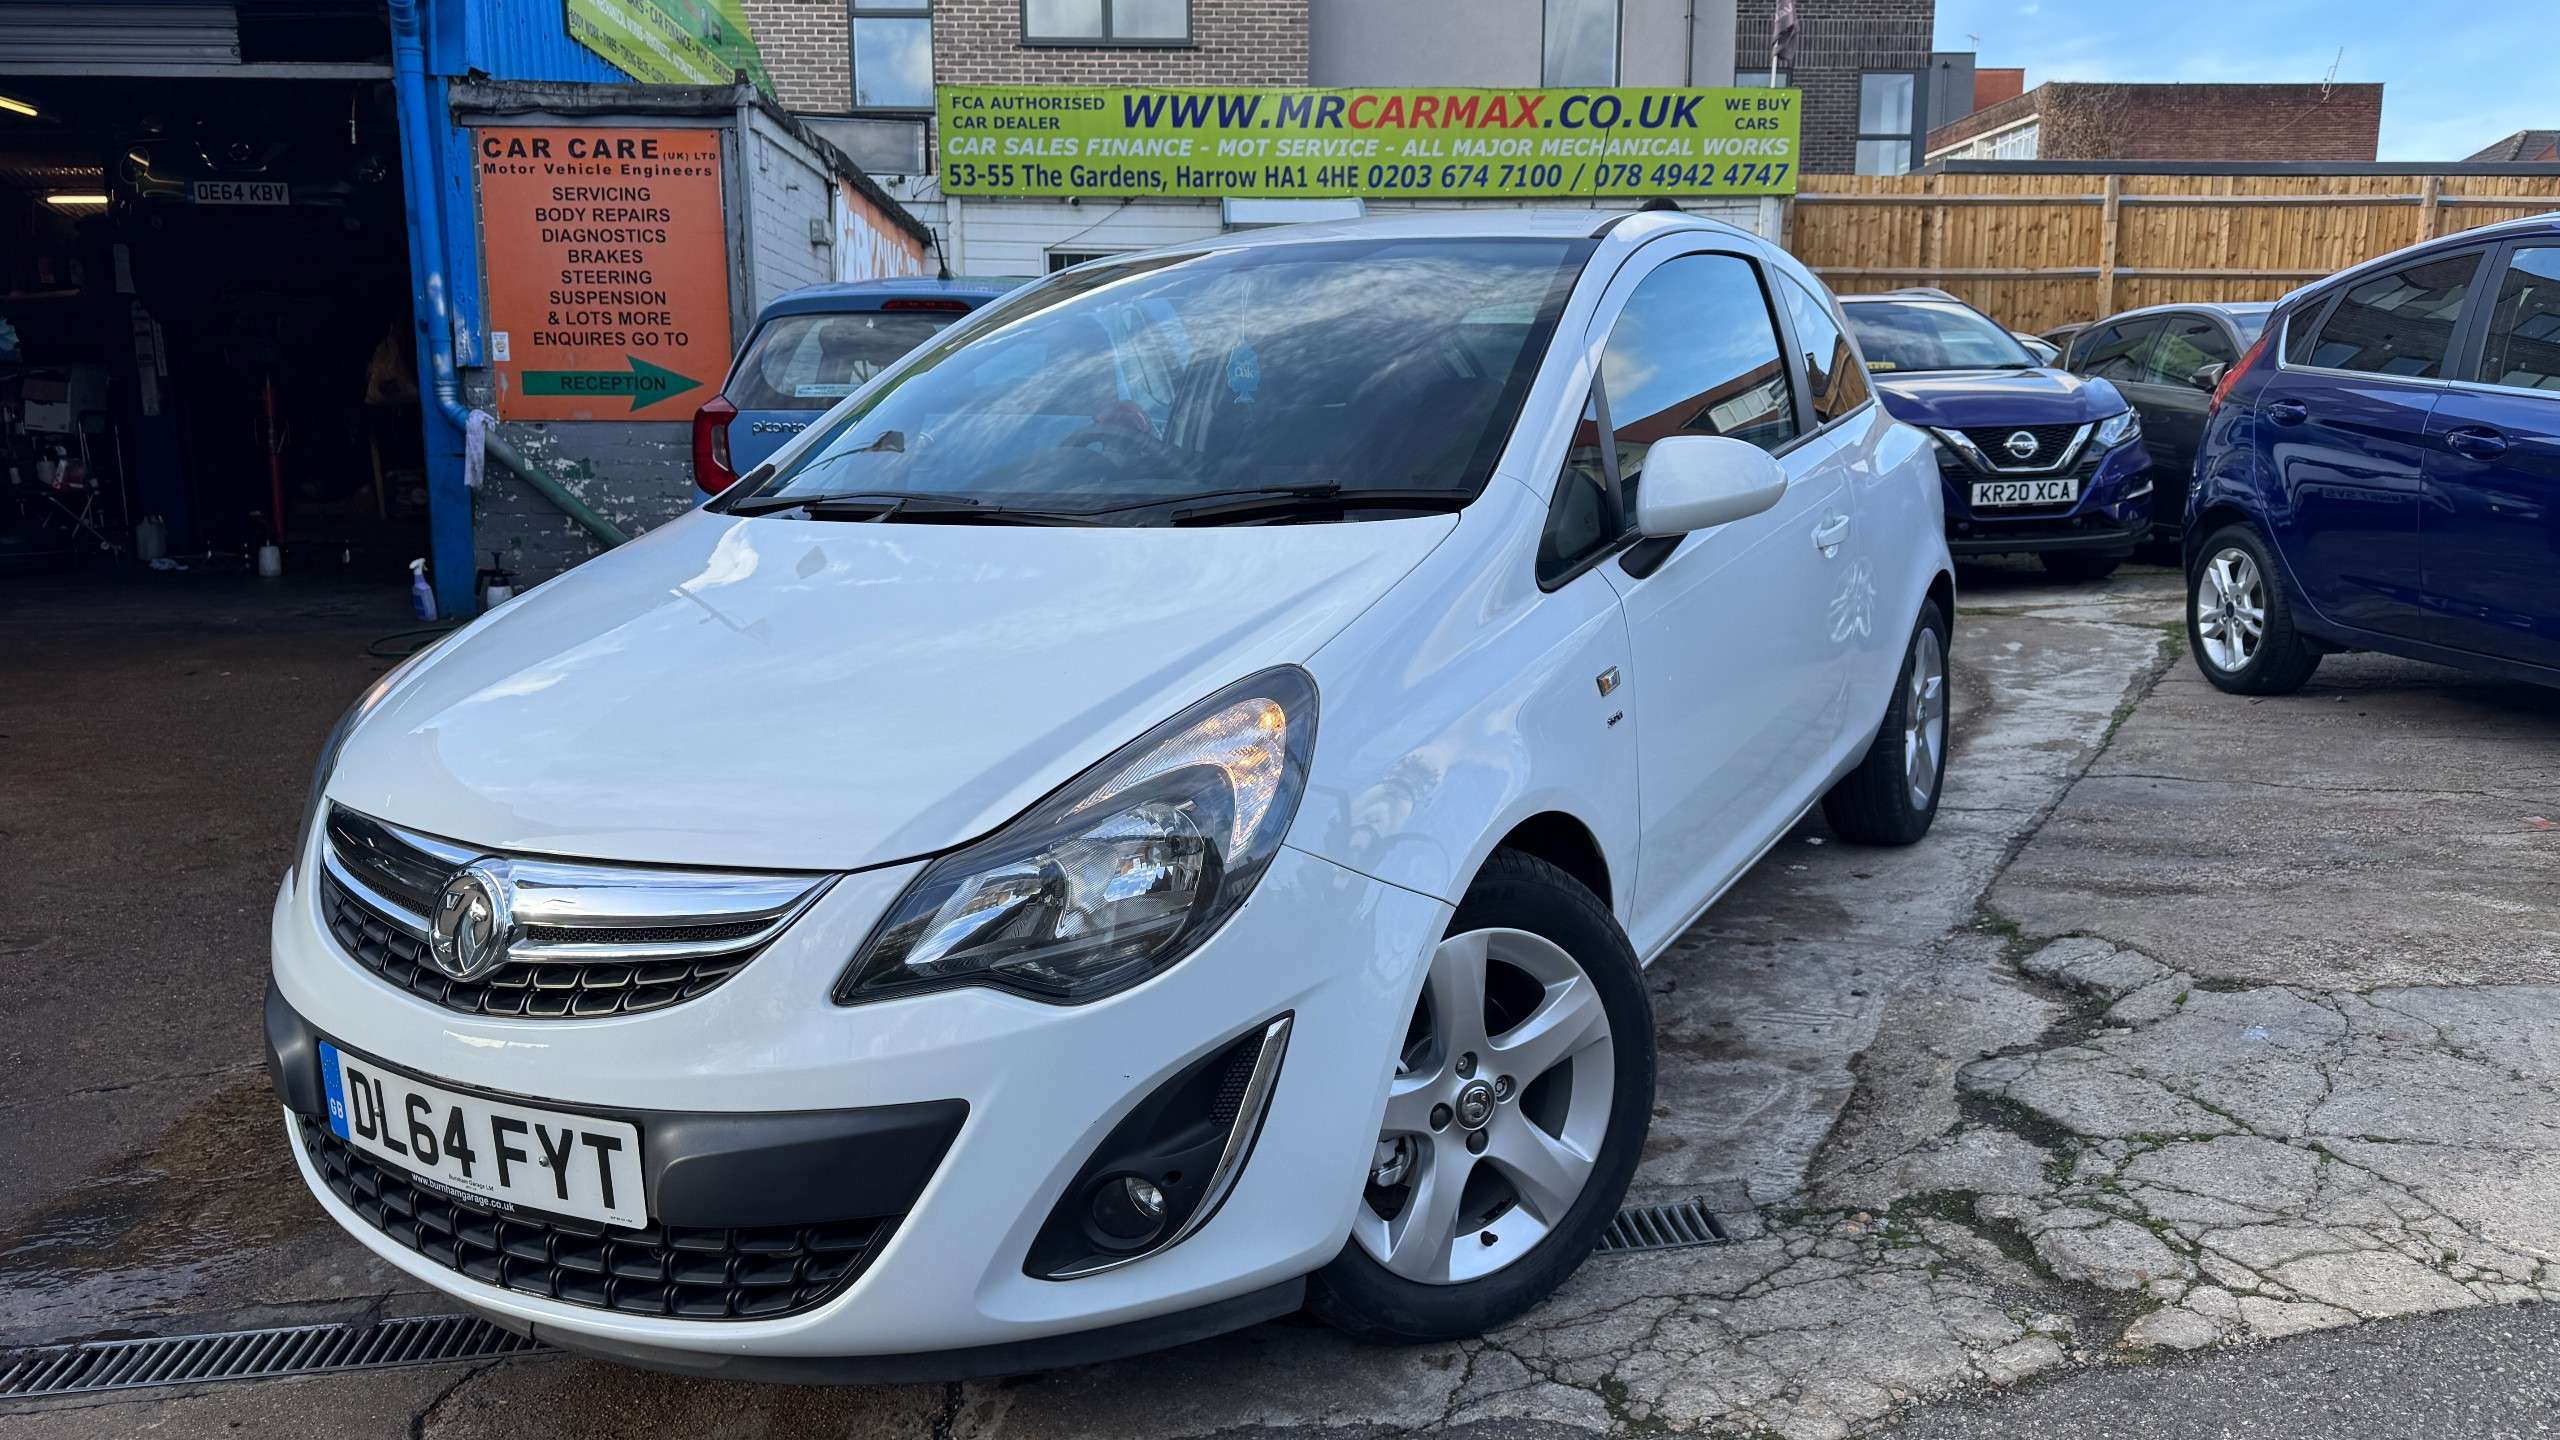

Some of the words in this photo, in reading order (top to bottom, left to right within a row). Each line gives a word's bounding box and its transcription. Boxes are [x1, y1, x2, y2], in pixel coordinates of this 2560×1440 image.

[952, 97, 985, 110] FCA
[991, 96, 1105, 111] AUTHORISED
[1725, 98, 1752, 111] WE
[1757, 98, 1791, 111] BUY
[1124, 95, 1705, 129] WWW.MRCARMAX.CO.UK
[952, 117, 987, 130] CAR
[993, 116, 1060, 131] DEALER
[1735, 117, 1780, 131] CARS
[482, 138, 551, 159] CAR
[567, 138, 659, 159] CARE
[663, 152, 689, 162] (UK)
[694, 152, 717, 161] LTD
[948, 137, 996, 157] CAR
[1004, 137, 1078, 157] SALES
[1086, 138, 1193, 158] FINANCE
[1217, 138, 1270, 158] MOT
[1275, 138, 1376, 158] SERVICE
[1402, 138, 1444, 157] ALL
[1452, 138, 1533, 157] MAJOR
[1541, 137, 1694, 157] MECHANICAL
[1703, 137, 1789, 157] WORKS
[483, 164, 536, 175] Motor
[545, 164, 612, 176] Vehicle
[621, 165, 713, 178] Engineers
[949, 163, 1014, 187] 53-55
[1021, 163, 1062, 187] The
[1070, 164, 1169, 192] Gardens,
[1176, 165, 1256, 188] Harrow
[1264, 166, 1308, 188] HA1
[1316, 165, 1359, 188] 4HE
[1368, 164, 1432, 188] 0203
[1441, 164, 1488, 188] 674
[1499, 164, 1562, 188] 7100
[1595, 164, 1641, 188] 078
[1651, 164, 1713, 187] 4942
[1723, 163, 1789, 187] 4747
[198, 183, 244, 200] OE64
[250, 184, 285, 202] KBV
[552, 187, 651, 201] SERVICING
[535, 208, 587, 222] BODY
[592, 208, 671, 222] REPAIRS
[542, 228, 667, 243] DIAGNOSTICS
[568, 250, 643, 264] BRAKES
[561, 270, 653, 285] STEERING
[550, 291, 667, 305] SUSPENSION
[548, 311, 559, 325] &
[566, 311, 613, 325] LOTS
[619, 311, 672, 325] MORE
[534, 331, 626, 347] ENQUIRES
[632, 331, 659, 346] GO
[664, 331, 689, 346] TO
[560, 376, 667, 390] RECEPTION
[1979, 484, 2030, 503] KR20
[2035, 482, 2071, 500] XCA
[330, 1096, 344, 1120] GB
[347, 1066, 477, 1178] DL64
[490, 1114, 623, 1210] FYT
[411, 1173, 515, 1213] www.burnhamgarage.co.uk
